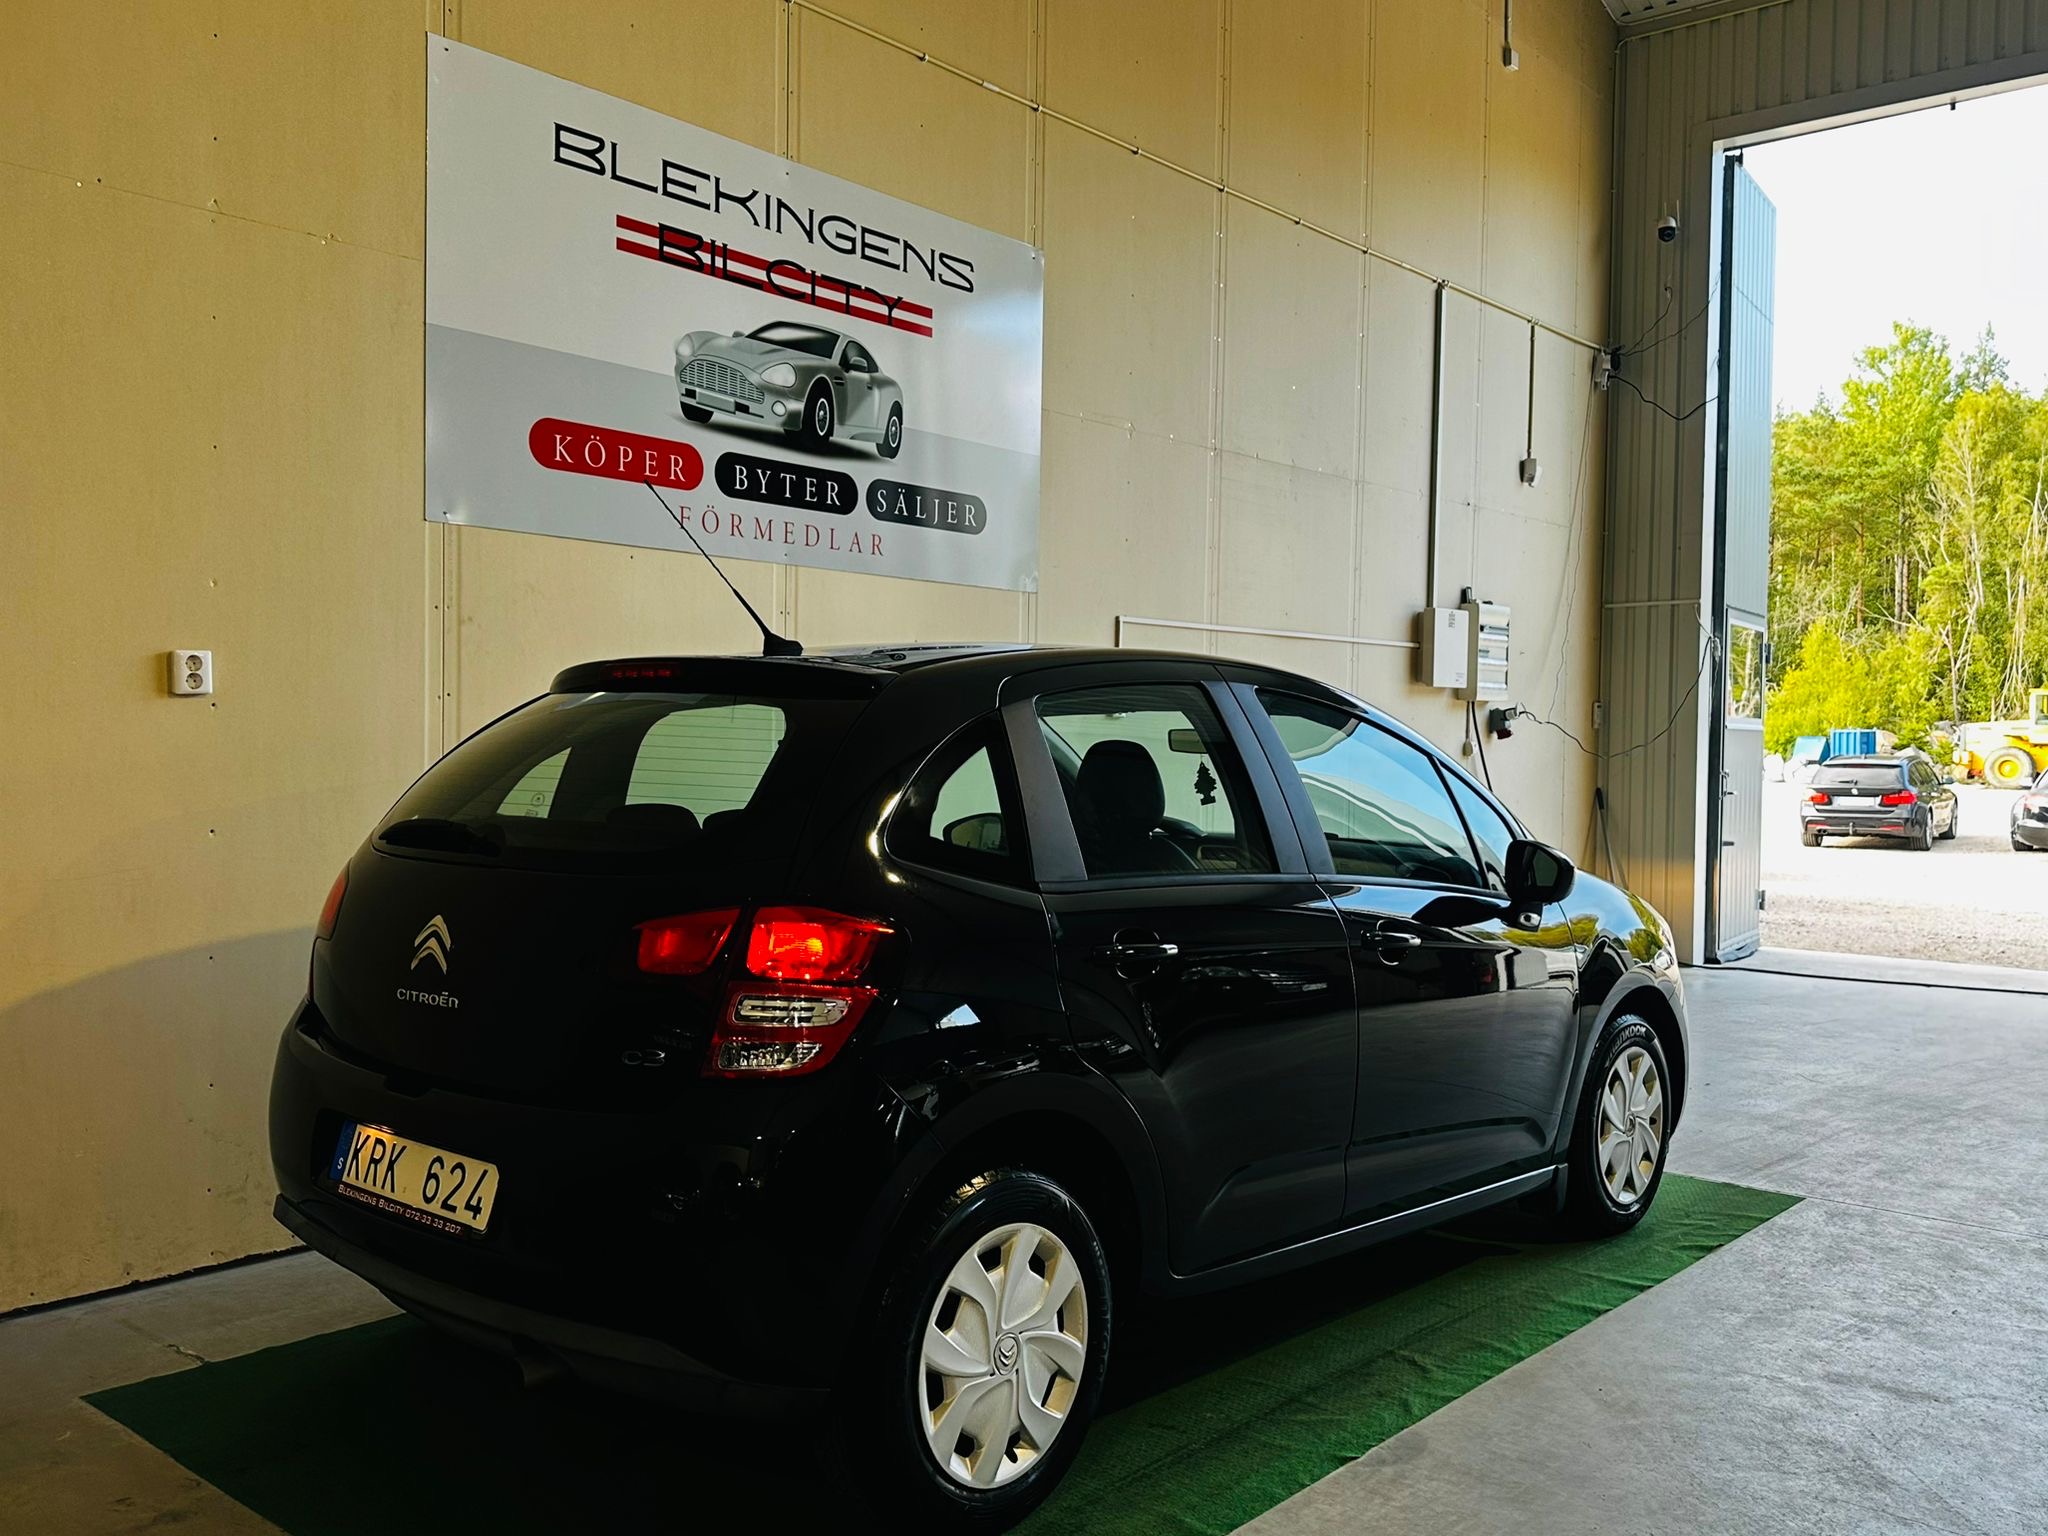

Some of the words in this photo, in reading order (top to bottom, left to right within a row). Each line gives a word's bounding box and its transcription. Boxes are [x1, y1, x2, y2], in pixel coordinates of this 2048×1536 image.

[552, 121, 974, 294] BLEKINGENS
[657, 222, 903, 327] BILCITY
[554, 433, 687, 482] KÖPER
[733, 464, 841, 506] BYTER
[876, 488, 978, 528] SÄLJER
[679, 505, 885, 558] FÖRMEDLAR
[621, 1049, 666, 1066] C3
[336, 1157, 344, 1170] S
[346, 1131, 407, 1192] KRK
[421, 1155, 488, 1220] 624
